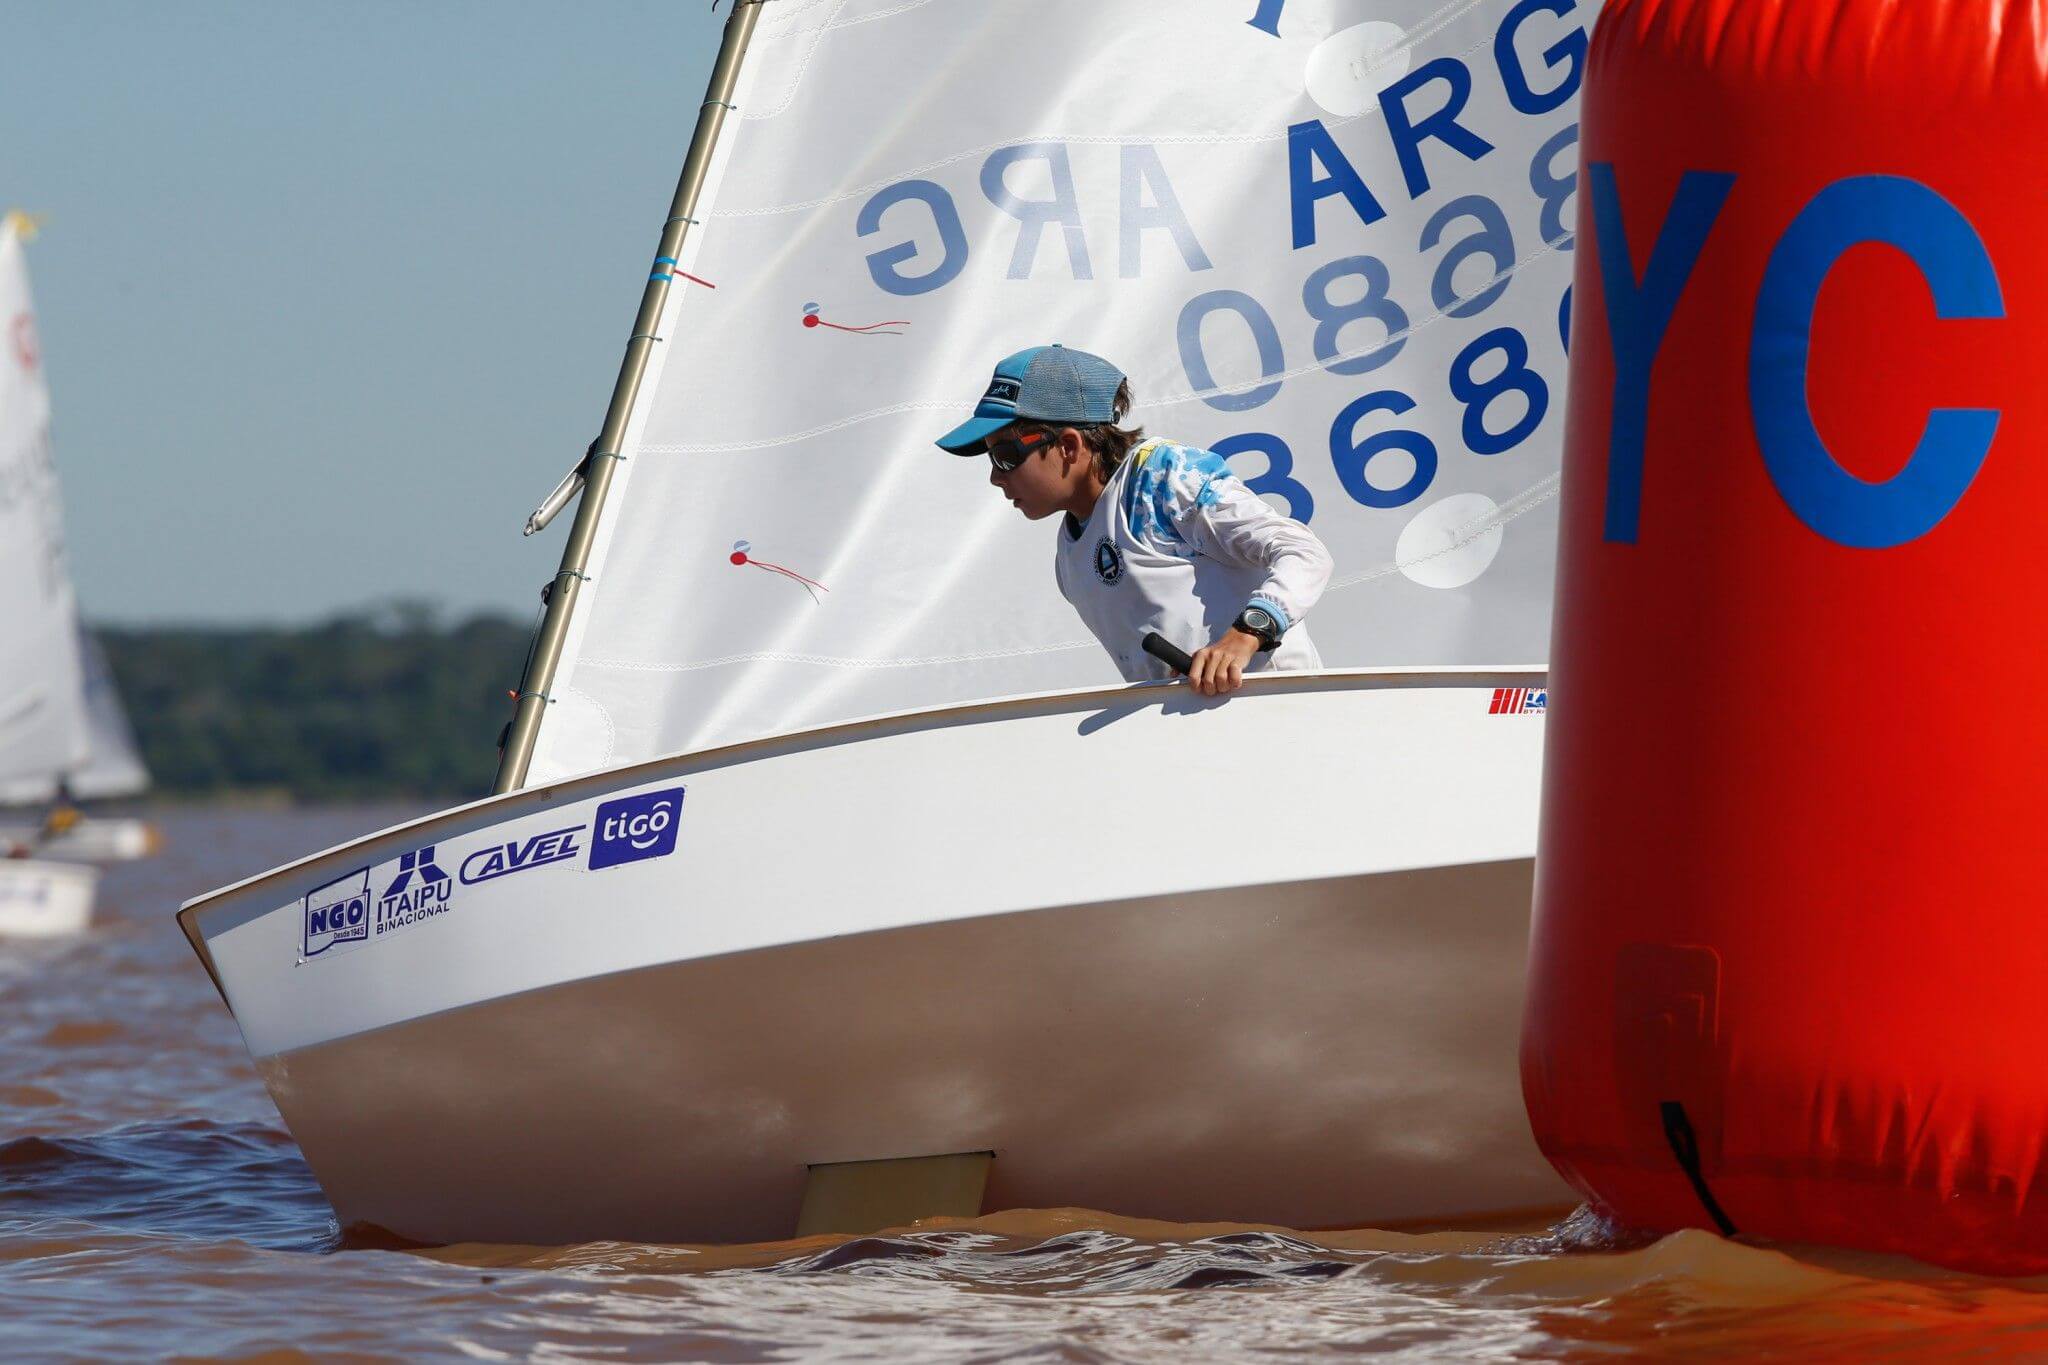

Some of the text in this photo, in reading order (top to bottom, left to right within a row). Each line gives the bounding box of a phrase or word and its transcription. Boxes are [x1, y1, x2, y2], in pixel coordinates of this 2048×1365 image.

[1288, 0, 1589, 249] ARG
[1588, 161, 2006, 549] YC
[1208, 283, 1572, 524] 368
[459, 824, 587, 885] CAVEL
[311, 899, 364, 934] NGO
[376, 903, 450, 934] BINACIONAL
[377, 878, 452, 923] ITAIPU
